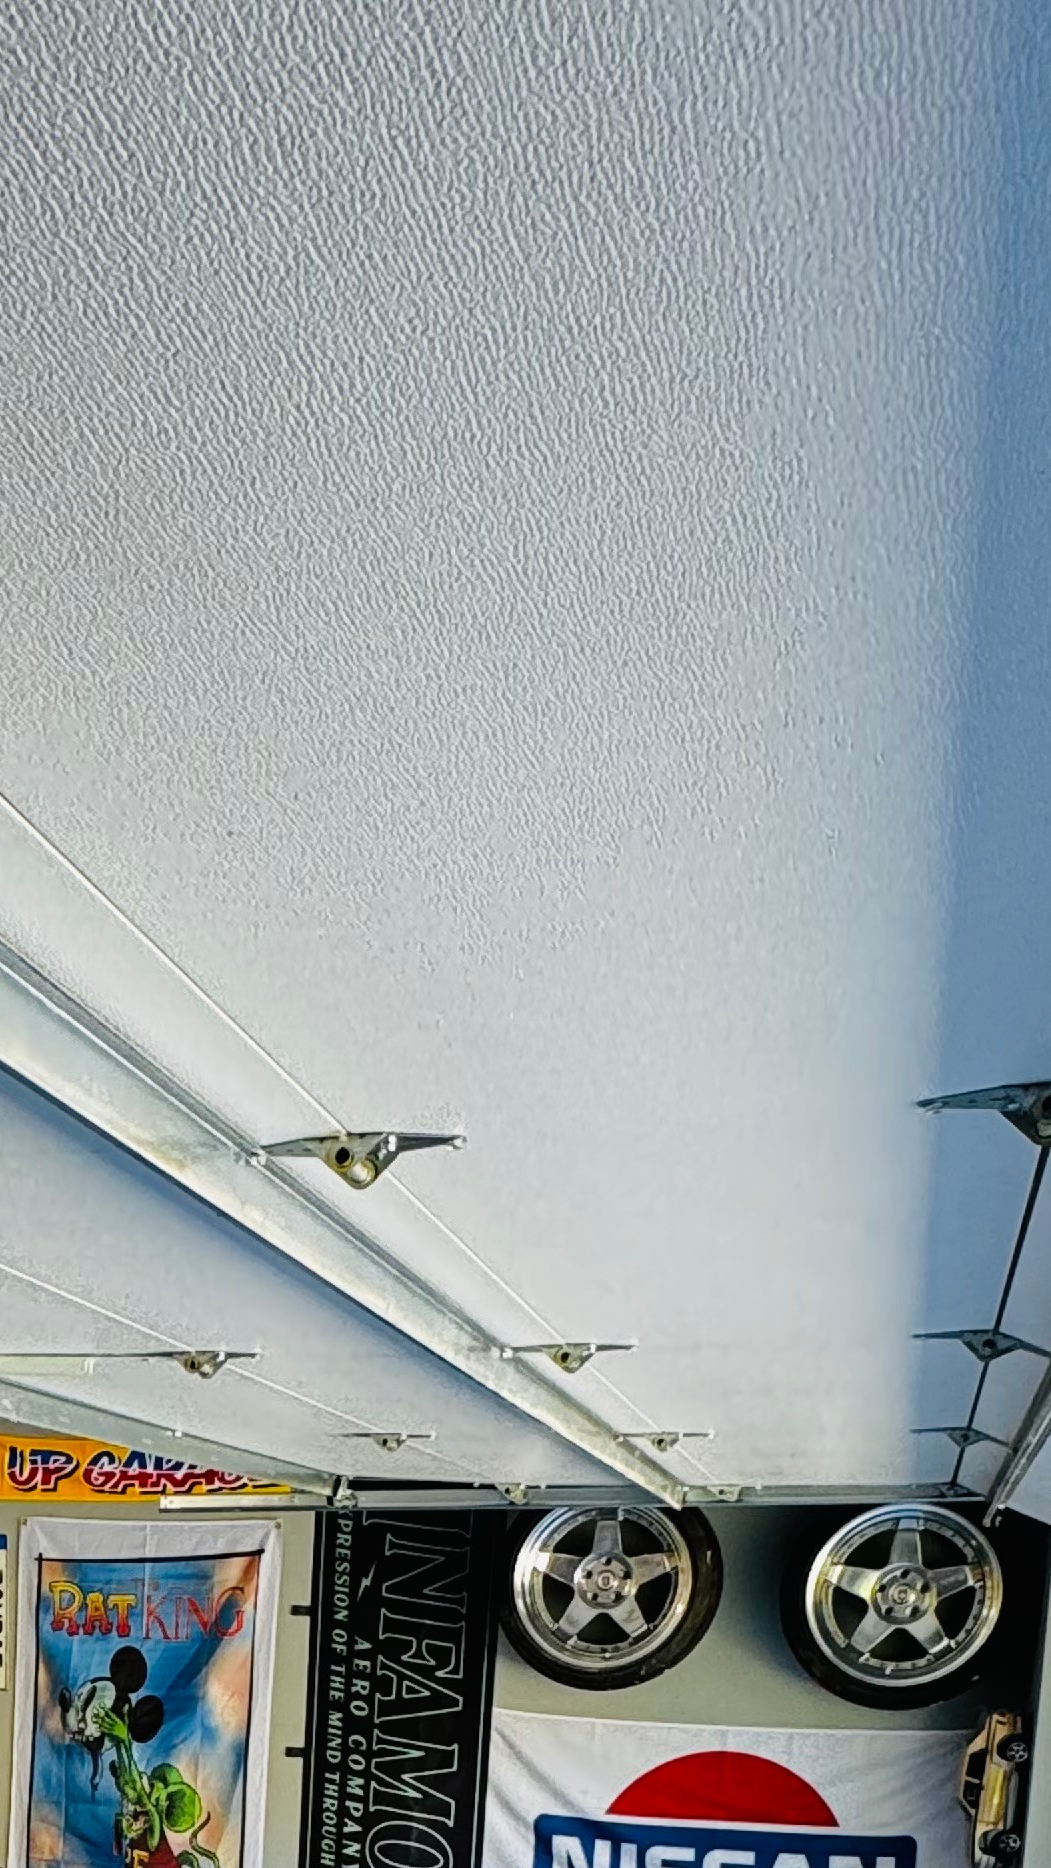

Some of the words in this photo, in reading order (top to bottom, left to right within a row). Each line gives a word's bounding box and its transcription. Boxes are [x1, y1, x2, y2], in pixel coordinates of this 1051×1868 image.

[5, 1446, 79, 1492] UP
[49, 1579, 137, 1637] RAT
[143, 1586, 245, 1642] KING
[330, 1628, 348, 1656] OF
[328, 1663, 346, 1702] THE
[349, 1635, 374, 1718] AERO
[326, 1710, 344, 1764] MIND
[319, 1771, 340, 1867] THROUGH
